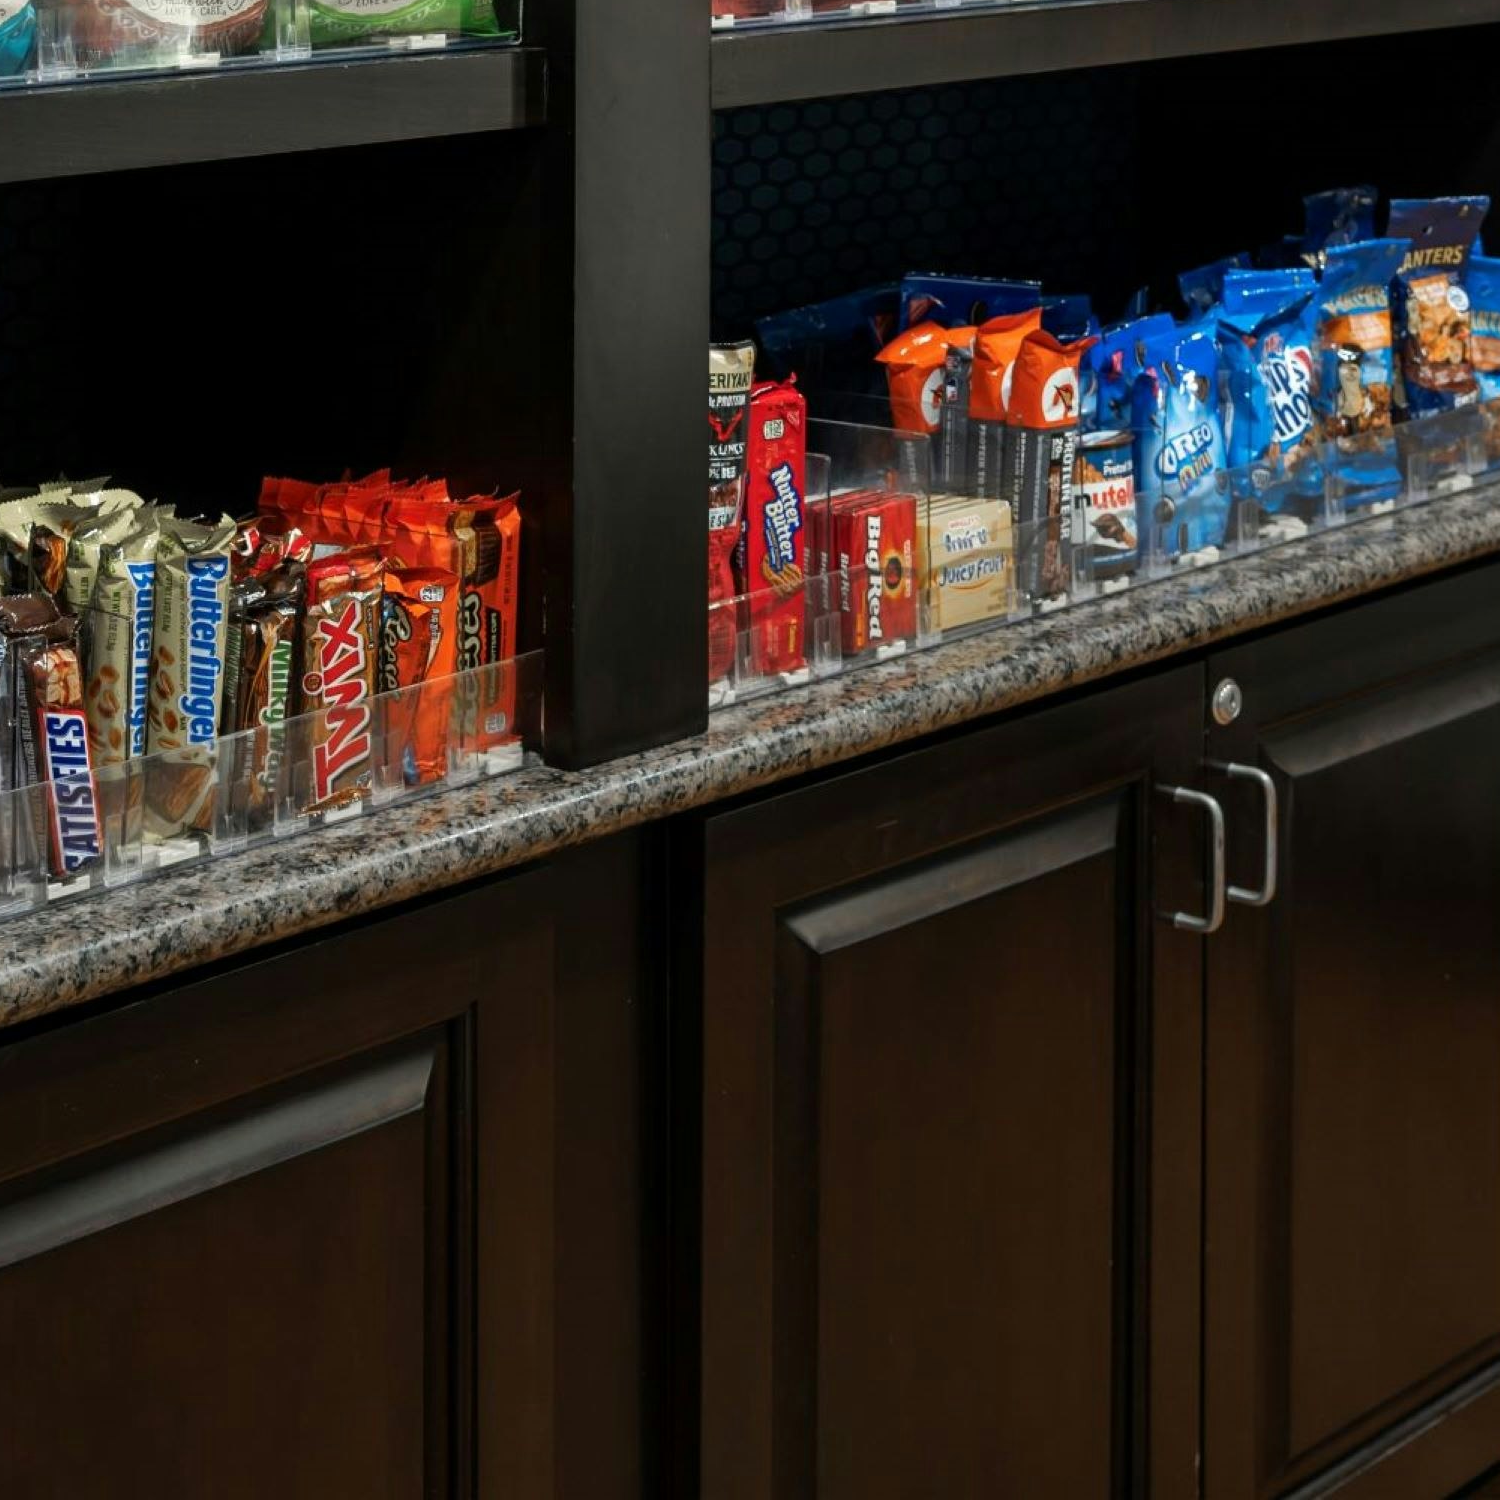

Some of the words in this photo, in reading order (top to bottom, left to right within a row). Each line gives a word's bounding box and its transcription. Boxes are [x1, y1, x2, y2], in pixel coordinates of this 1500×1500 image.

[1398, 246, 1464, 272] ANTERS
[1157, 423, 1212, 475] OREO
[771, 464, 800, 529] Nutter
[765, 500, 794, 562] Butter
[178, 555, 229, 752] Butterfinger
[306, 599, 371, 804] TWIX
